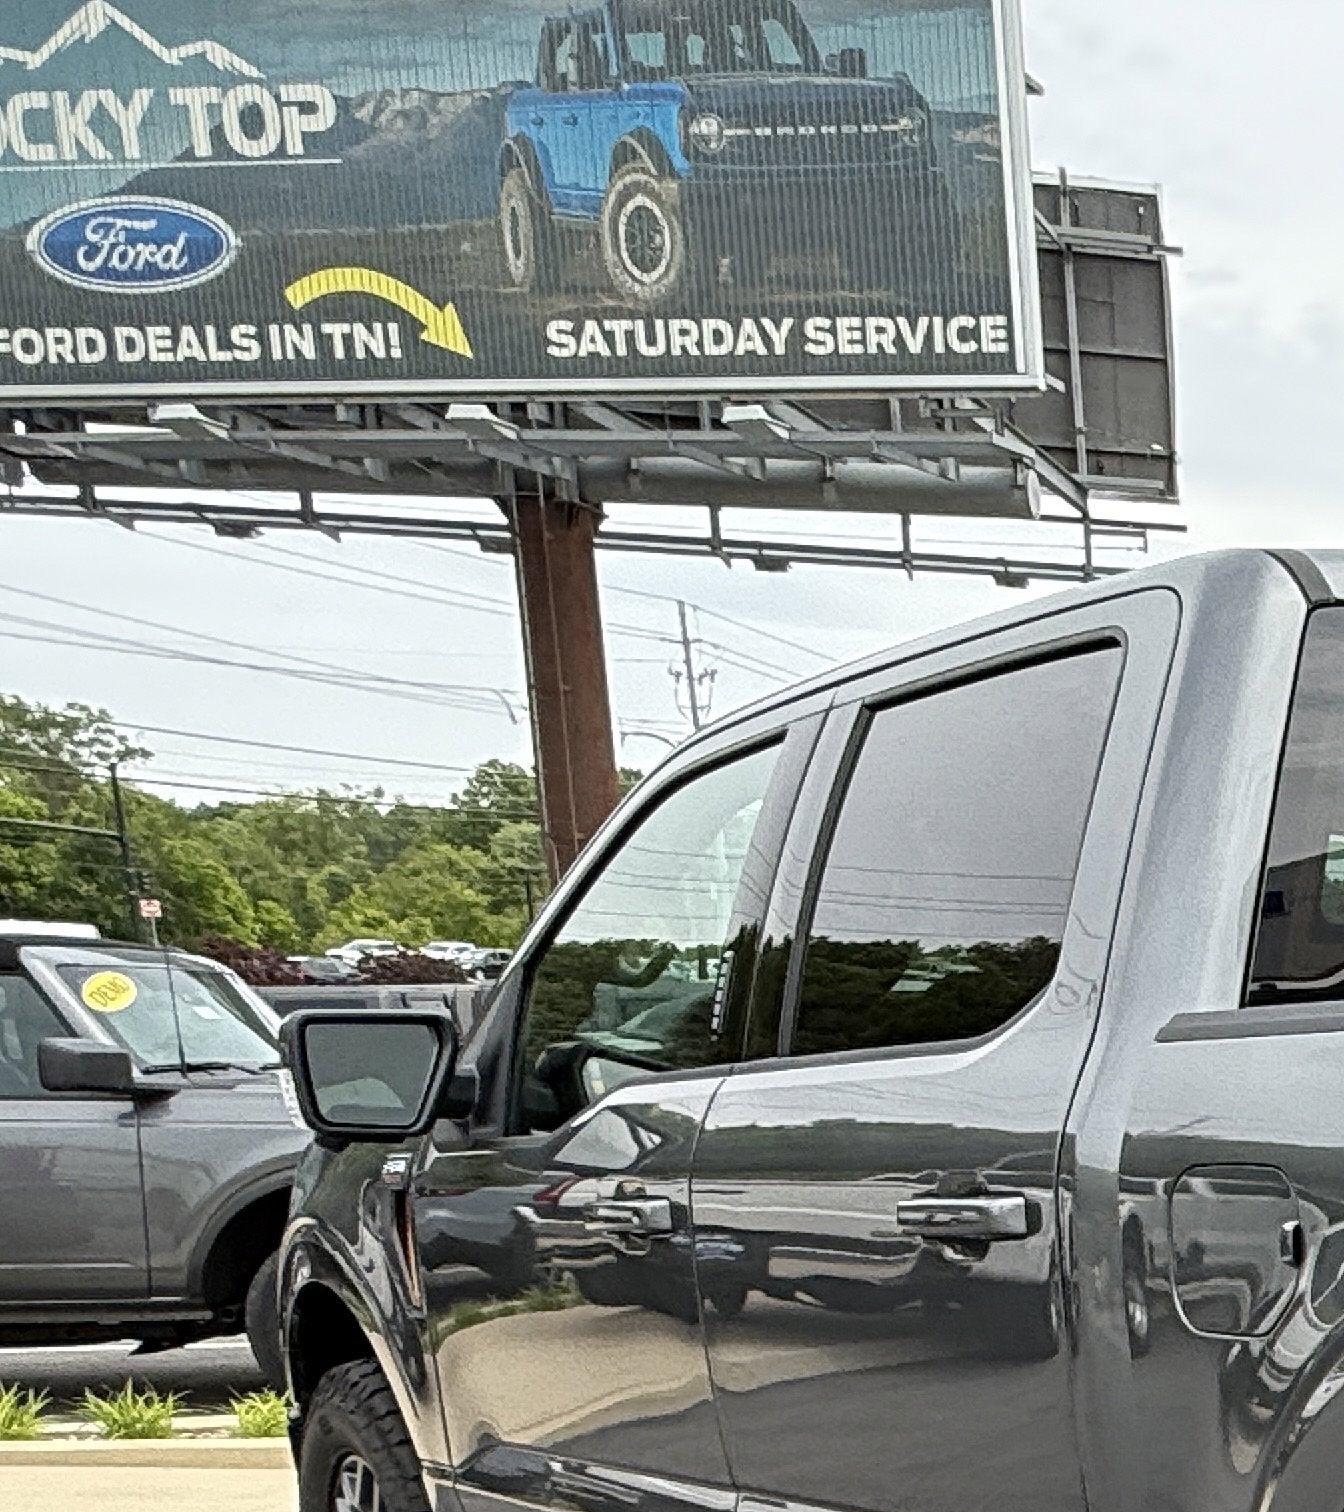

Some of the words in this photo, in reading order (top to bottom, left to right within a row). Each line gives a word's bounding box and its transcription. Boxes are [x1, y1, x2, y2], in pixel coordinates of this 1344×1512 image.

[0, 88, 154, 161] CKY
[168, 83, 337, 158] TOP
[76, 216, 188, 272] Ford
[114, 325, 262, 362] DEALS
[268, 324, 316, 361] IN
[321, 322, 402, 360] TN!
[546, 317, 793, 358] SATURDAY
[803, 314, 1010, 355] SERVICE
